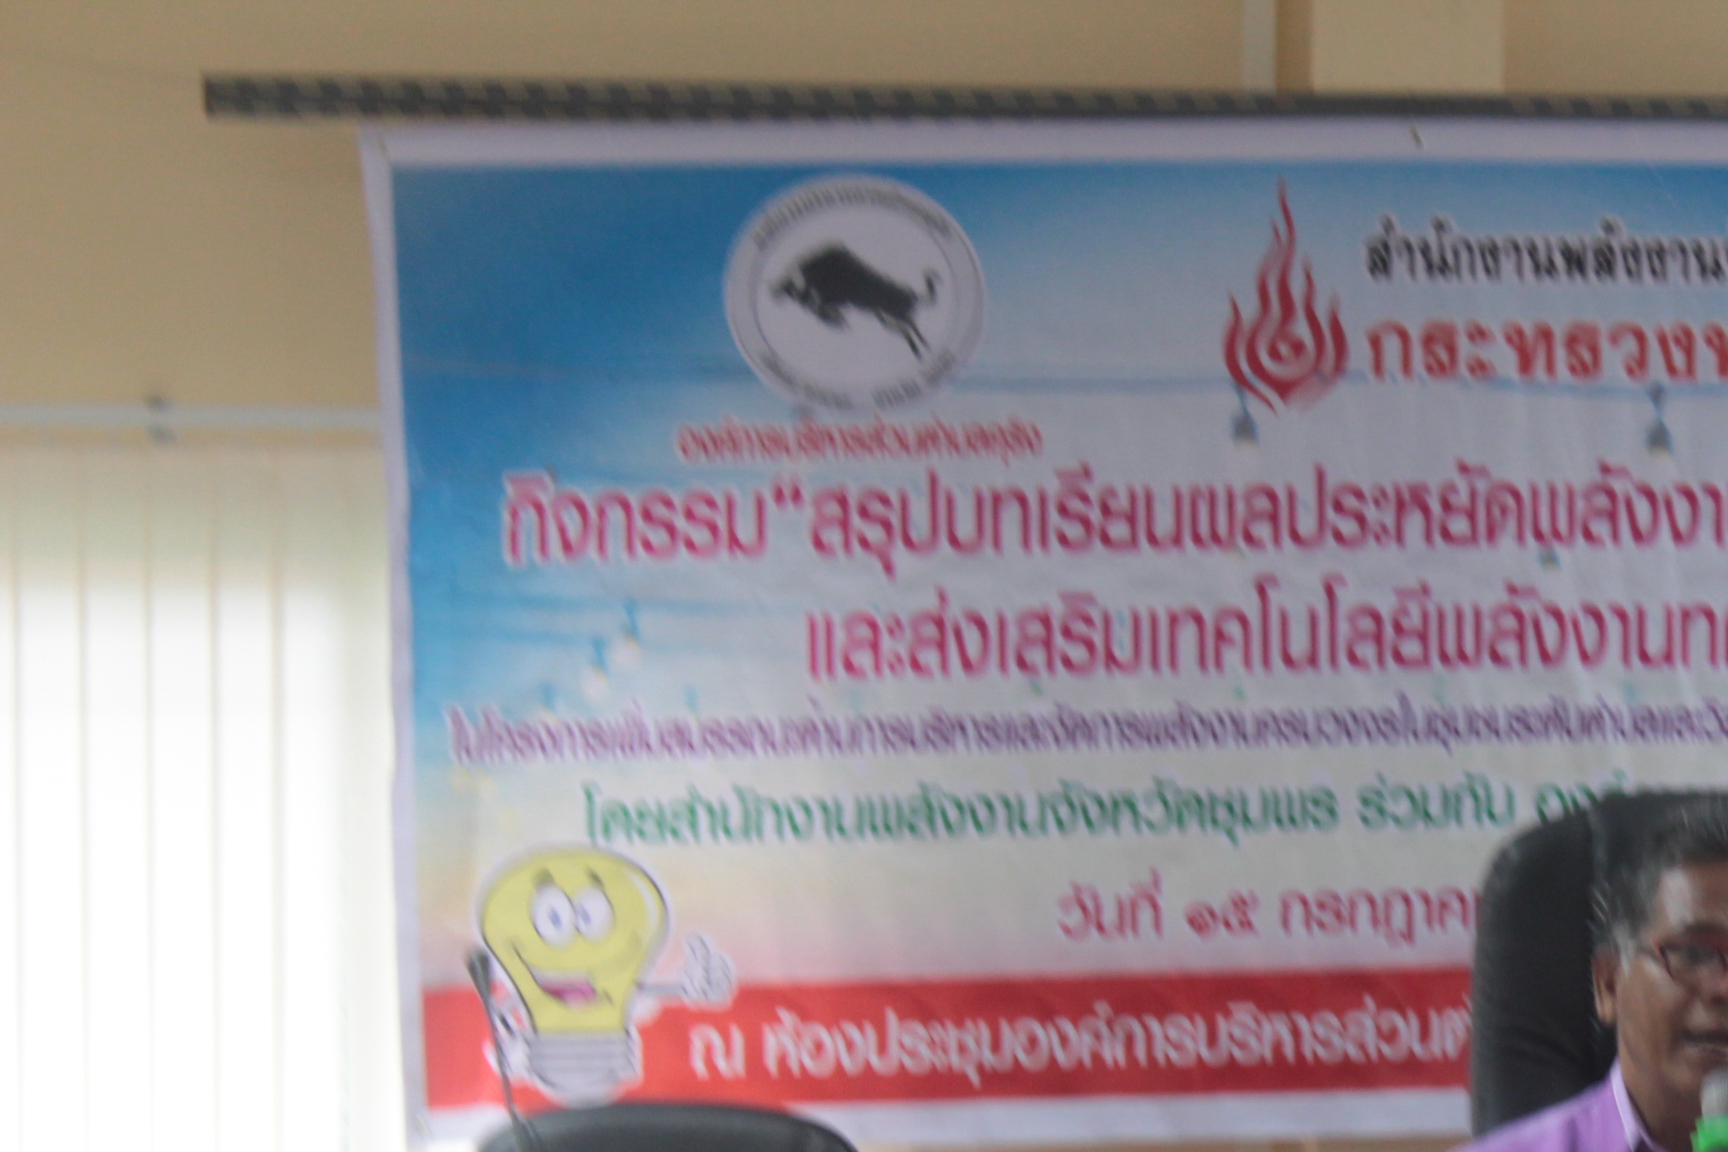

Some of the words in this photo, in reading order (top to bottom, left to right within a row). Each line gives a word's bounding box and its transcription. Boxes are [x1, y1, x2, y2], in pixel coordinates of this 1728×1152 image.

[1059, 866, 1164, 939] วันที่
[1278, 885, 1480, 947] กรกฎาค
[689, 1021, 746, 1081] ณ
